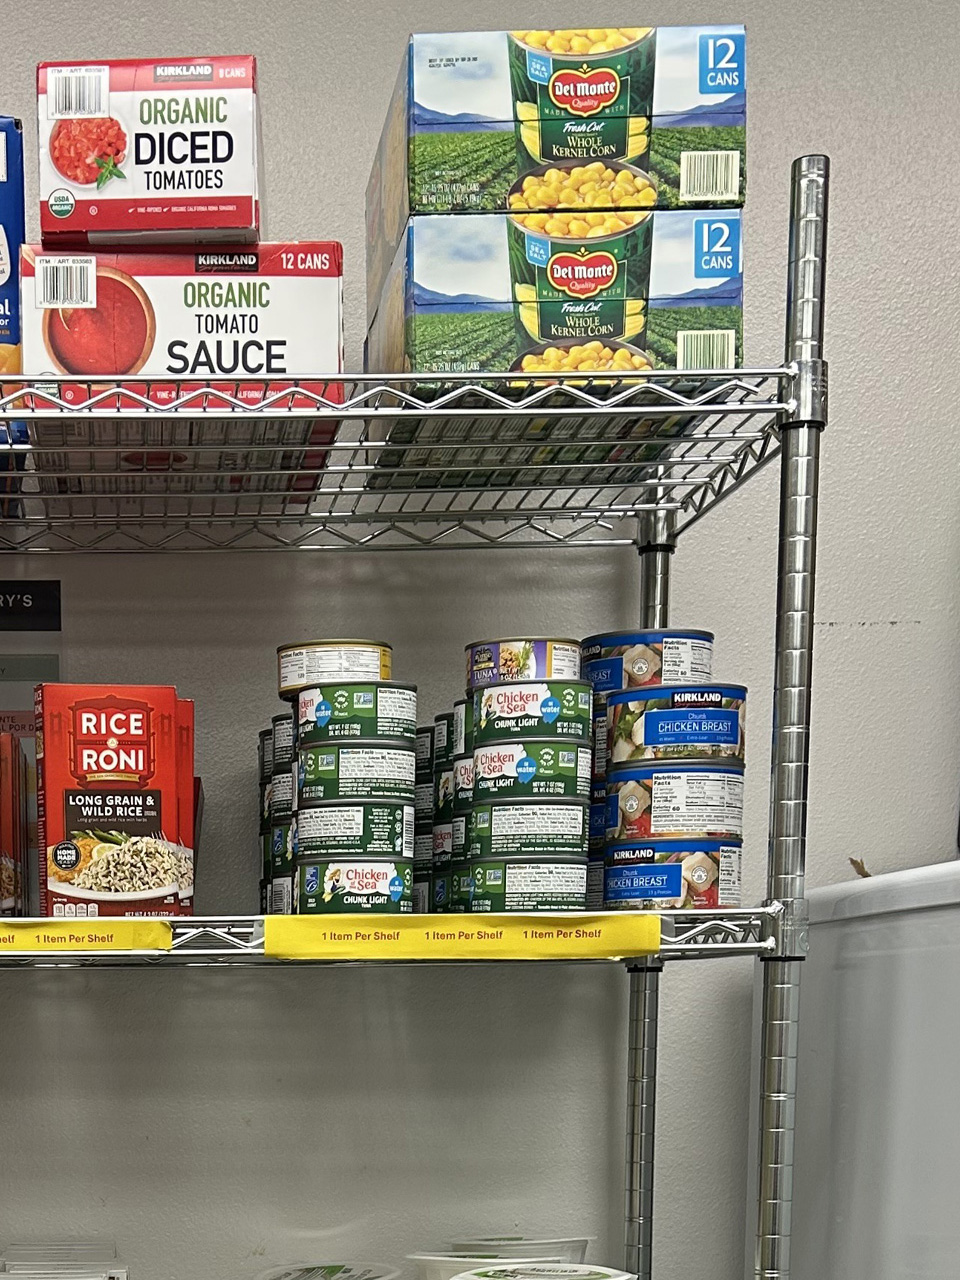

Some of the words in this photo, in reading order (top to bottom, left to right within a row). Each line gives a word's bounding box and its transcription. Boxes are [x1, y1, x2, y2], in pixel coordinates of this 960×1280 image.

[707, 38, 737, 69] 12
[156, 66, 211, 76] KIRKLAND
[225, 68, 245, 78] CANS
[708, 72, 738, 87] CANS
[554, 81, 576, 96] Del
[576, 80, 616, 95] Monte
[572, 98, 598, 107] Quality
[140, 97, 228, 124] ORGANIC
[563, 123, 585, 132] Fresh
[588, 122, 605, 132] Cut
[134, 131, 233, 165] DICED
[567, 136, 602, 147] WHOLE
[552, 145, 589, 157] KERNEL
[590, 144, 616, 157] CORN
[144, 170, 223, 191] TOMATOES
[198, 256, 256, 265] KIRKLAND
[281, 255, 294, 268] 12
[297, 253, 329, 269] CANS
[184, 282, 270, 308] ORGANIC
[195, 314, 258, 333] TOMATO
[166, 340, 286, 374] SAUCE
[674, 693, 721, 702] KIRKLAND
[81, 713, 143, 735] RICE
[659, 722, 699, 733] CHICKEN
[702, 722, 731, 732] BREAST
[82, 749, 144, 771] RONI
[69, 796, 103, 806] LONG
[106, 796, 144, 806] GRAIN
[146, 796, 154, 806] &
[81, 806, 113, 816] WILD
[116, 806, 143, 816] RICE
[346, 869, 388, 880] Chicken
[357, 879, 377, 890] Sea
[343, 896, 367, 904] CHUNK
